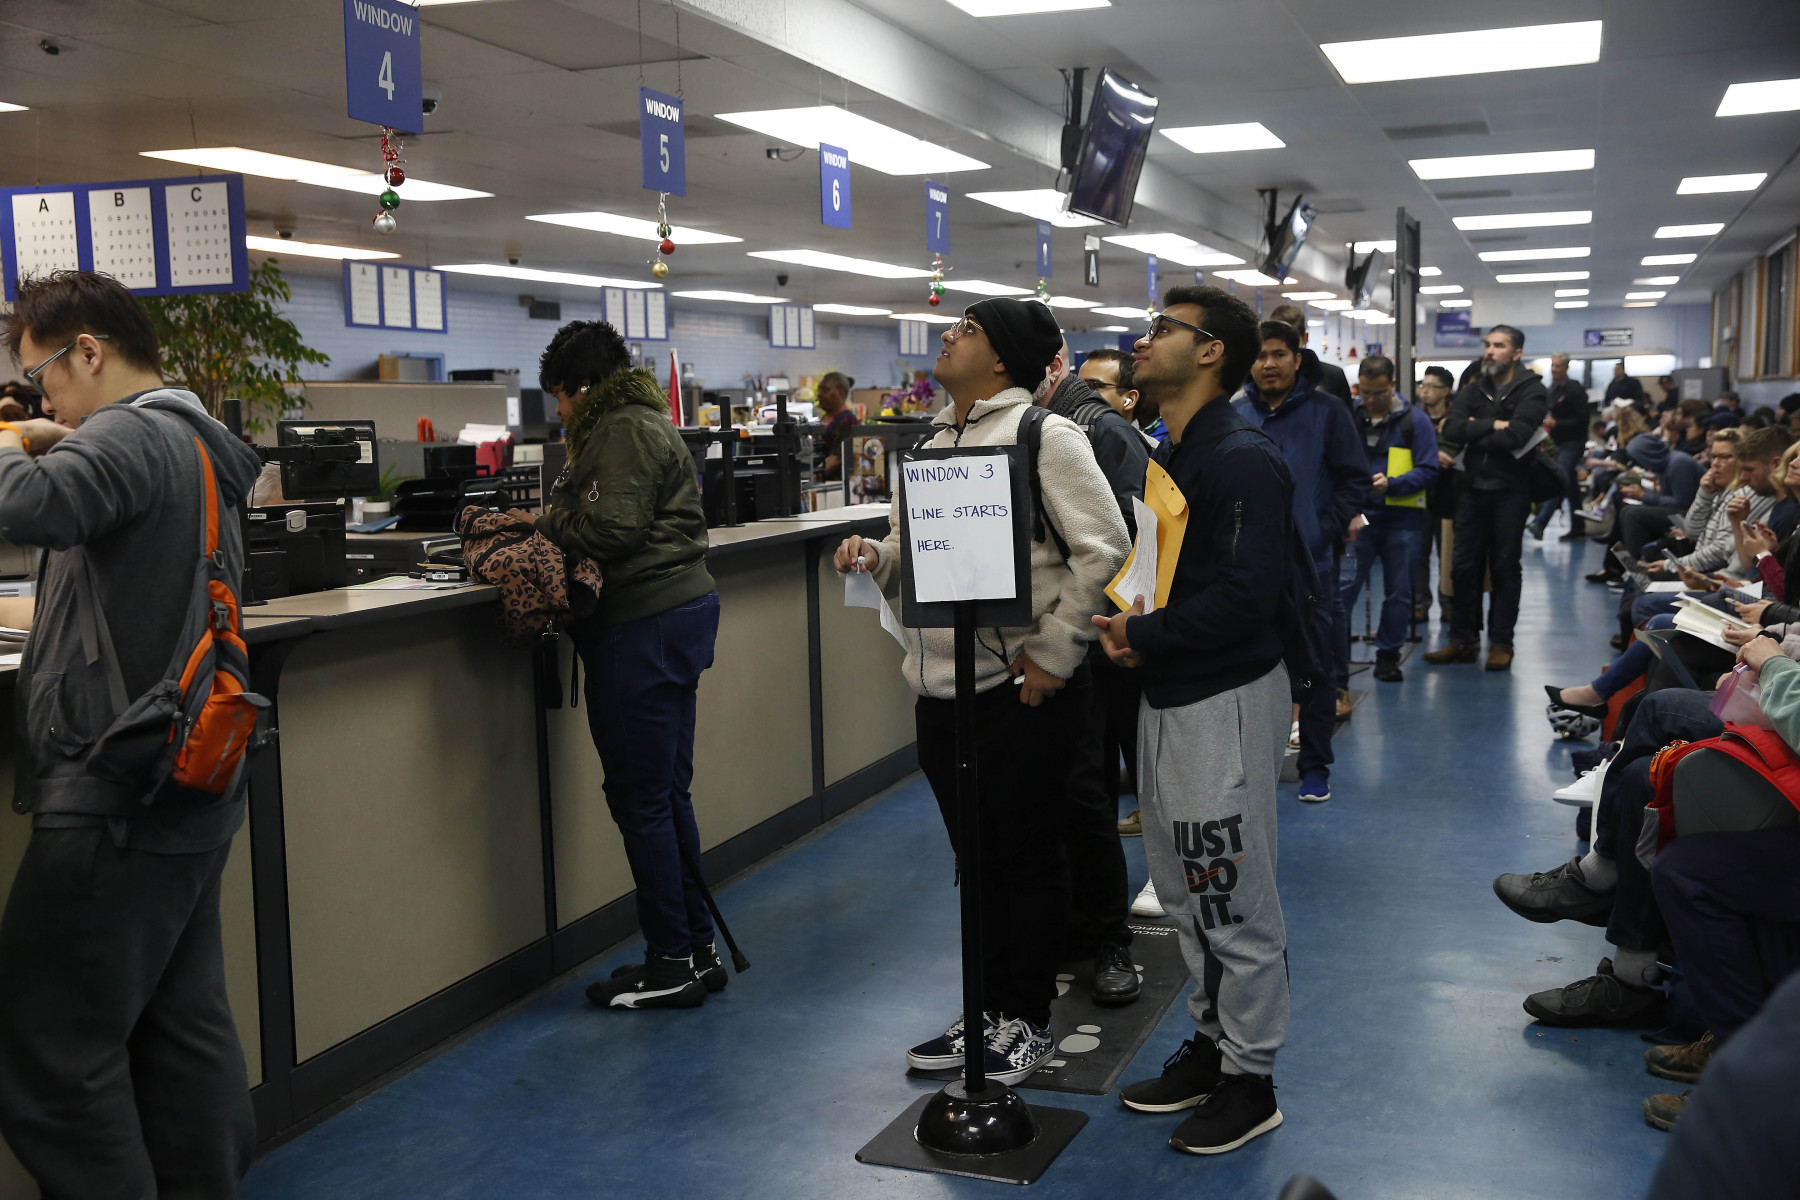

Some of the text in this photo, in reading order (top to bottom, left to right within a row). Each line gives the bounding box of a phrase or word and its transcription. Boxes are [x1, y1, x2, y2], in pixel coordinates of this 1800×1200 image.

[353, 0, 413, 37] WINDOW
[378, 51, 395, 101] 4
[645, 97, 680, 123] WINDOW
[660, 133, 670, 173] 5
[823, 150, 847, 170] WINDOW
[39, 198, 49, 213] A
[114, 192, 125, 207] B
[191, 187, 202, 202] C
[832, 178, 840, 212] 6
[929, 187, 948, 204] WINDOW
[935, 211, 942, 239] 7
[905, 463, 994, 482] WINDOW 3
[912, 504, 1008, 520] LINE STARTS
[917, 539, 954, 552] HERE.
[1173, 813, 1243, 859] JUST
[1182, 857, 1238, 893] DO
[1199, 893, 1244, 930] IT.
